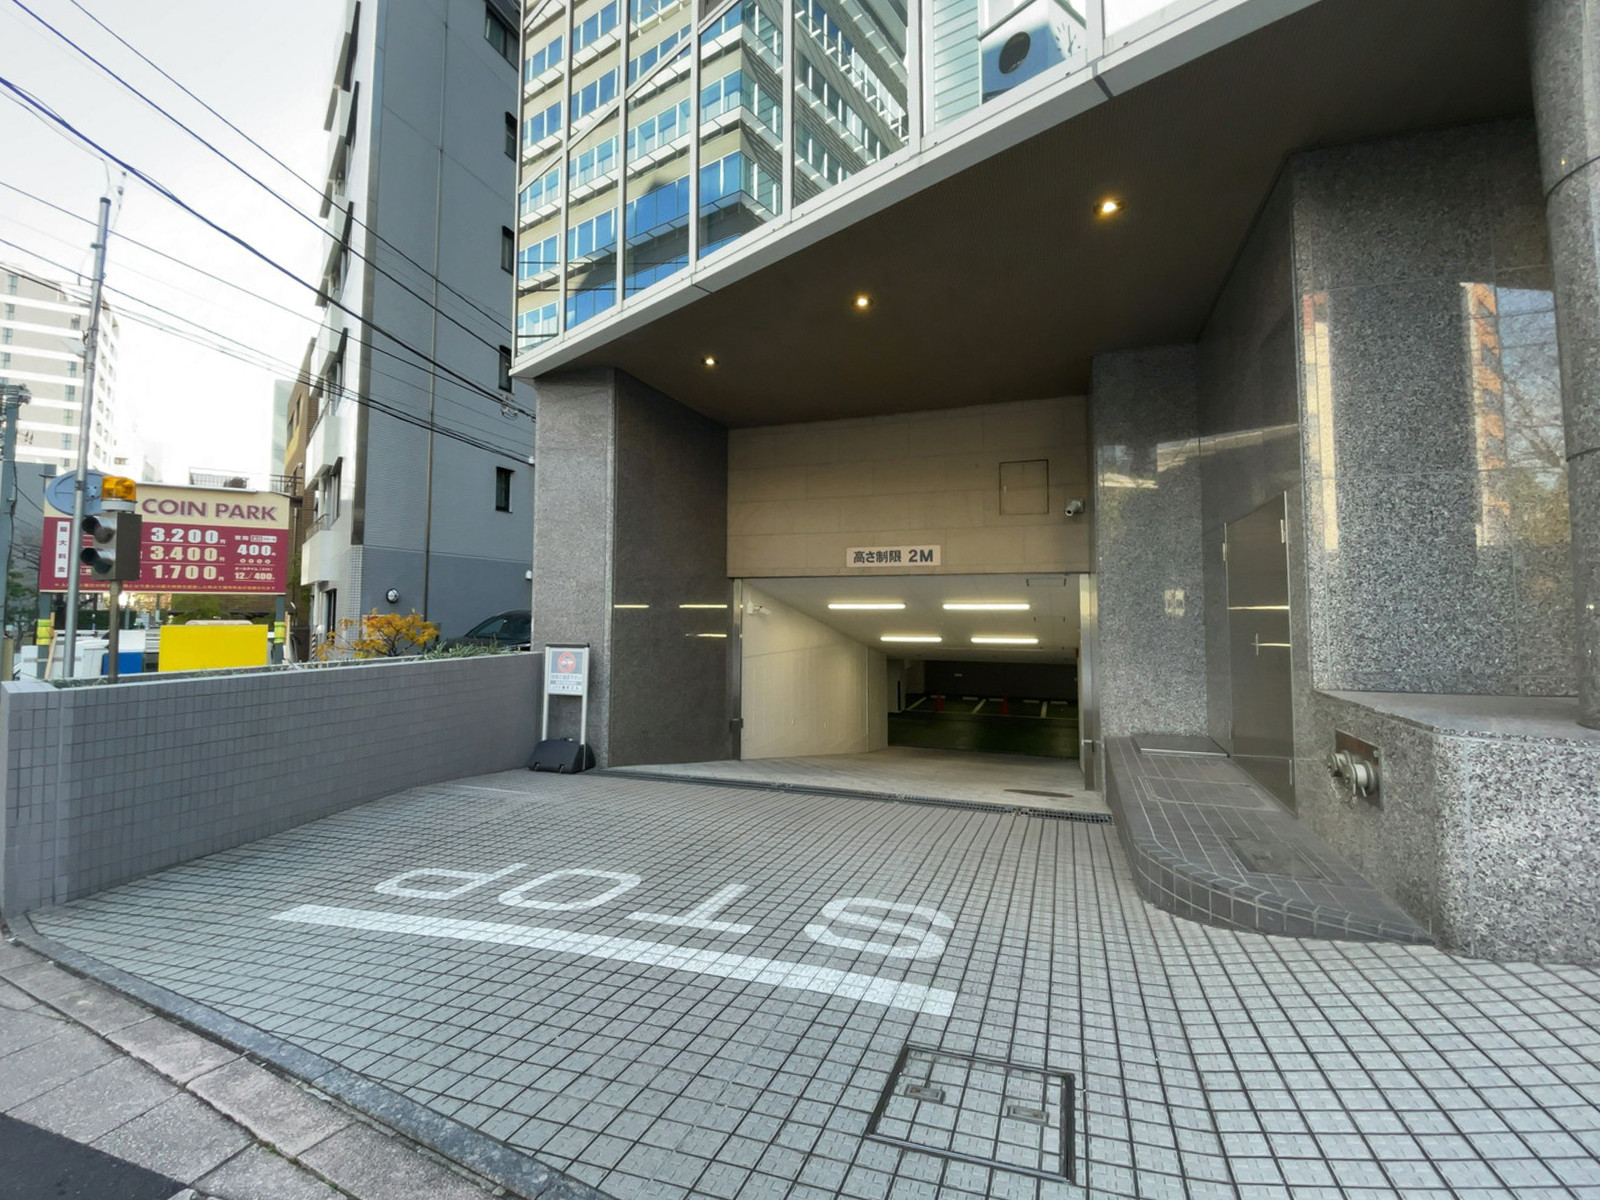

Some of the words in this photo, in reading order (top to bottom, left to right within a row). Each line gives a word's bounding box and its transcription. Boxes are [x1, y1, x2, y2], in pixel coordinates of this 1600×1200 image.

[142, 498, 206, 516] COIN
[215, 503, 278, 521] PARK
[853, 550, 901, 564] 高さ制限
[908, 549, 934, 562] 2M
[373, 862, 955, 960] STOP
